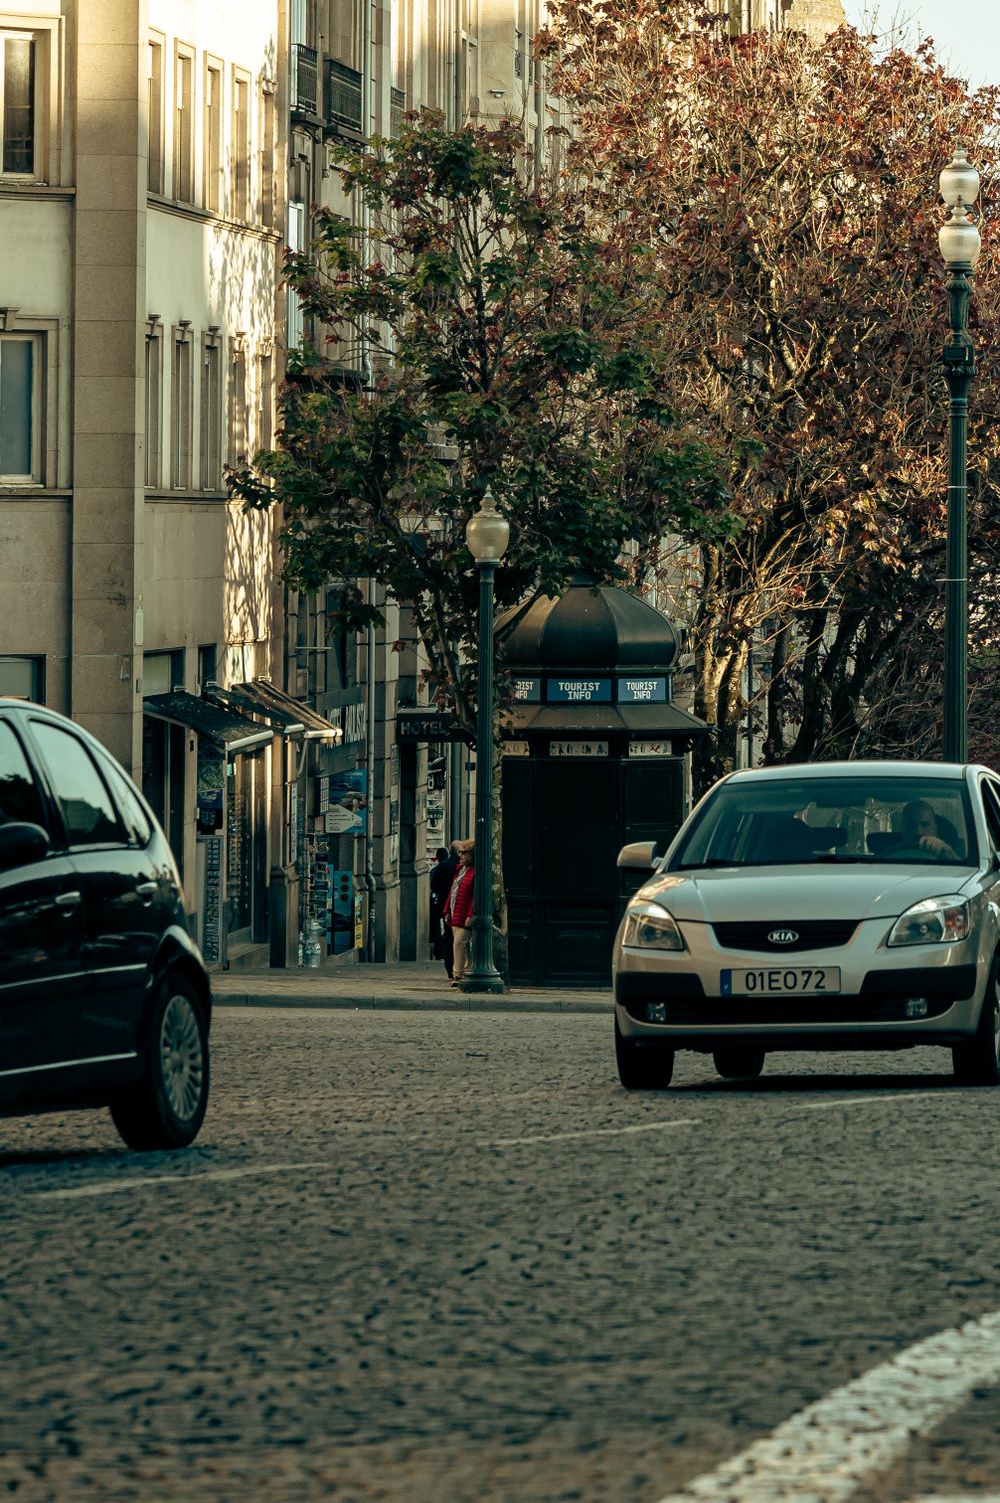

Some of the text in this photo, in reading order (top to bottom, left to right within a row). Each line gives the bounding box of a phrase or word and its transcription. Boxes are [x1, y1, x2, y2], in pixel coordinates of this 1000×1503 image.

[558, 682, 601, 691] TOURIST
[626, 681, 658, 691] TOURIST
[567, 691, 592, 700] INFO
[632, 690, 651, 700] INFO
[400, 721, 447, 736] HOTEL
[772, 932, 793, 941] KIA
